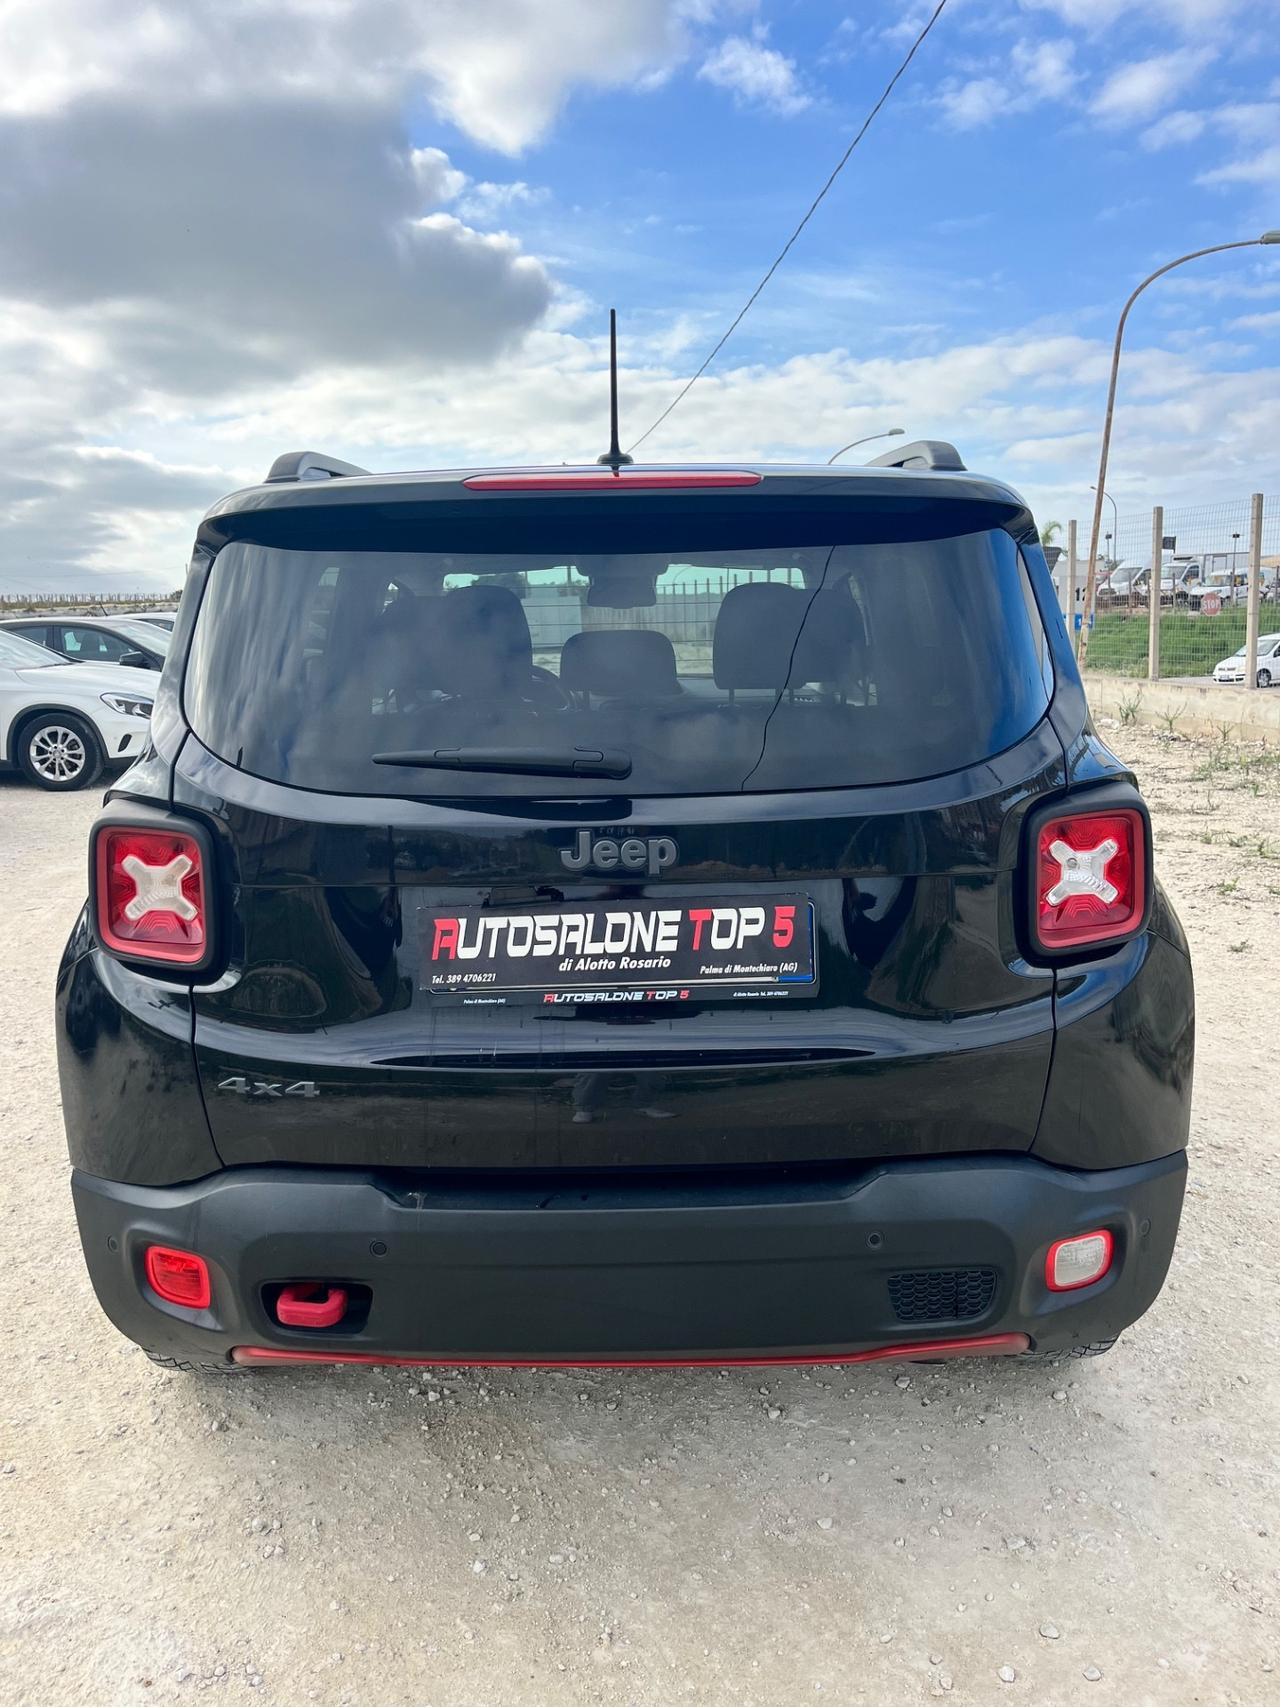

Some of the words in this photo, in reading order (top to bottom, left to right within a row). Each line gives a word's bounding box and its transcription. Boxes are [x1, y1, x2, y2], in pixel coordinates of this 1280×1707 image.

[560, 830, 677, 875] Jeep
[431, 909, 682, 961] AUTOSALONE
[688, 906, 766, 951] TOP
[772, 905, 797, 948] 5
[559, 958, 573, 971] di
[575, 957, 616, 971] Alotto
[620, 956, 671, 969] Rosario
[700, 965, 723, 974] Palma
[724, 964, 733, 974] di
[733, 963, 778, 973] Montechiaro
[780, 962, 798, 973] (AG)
[432, 975, 444, 984] Tel.
[446, 974, 462, 984] 389
[463, 973, 496, 983] 4706221
[544, 992, 644, 1003] AUTOSALONE
[646, 990, 677, 1001] TOP
[680, 990, 689, 1000] 5
[218, 1077, 320, 1098] 4x4
